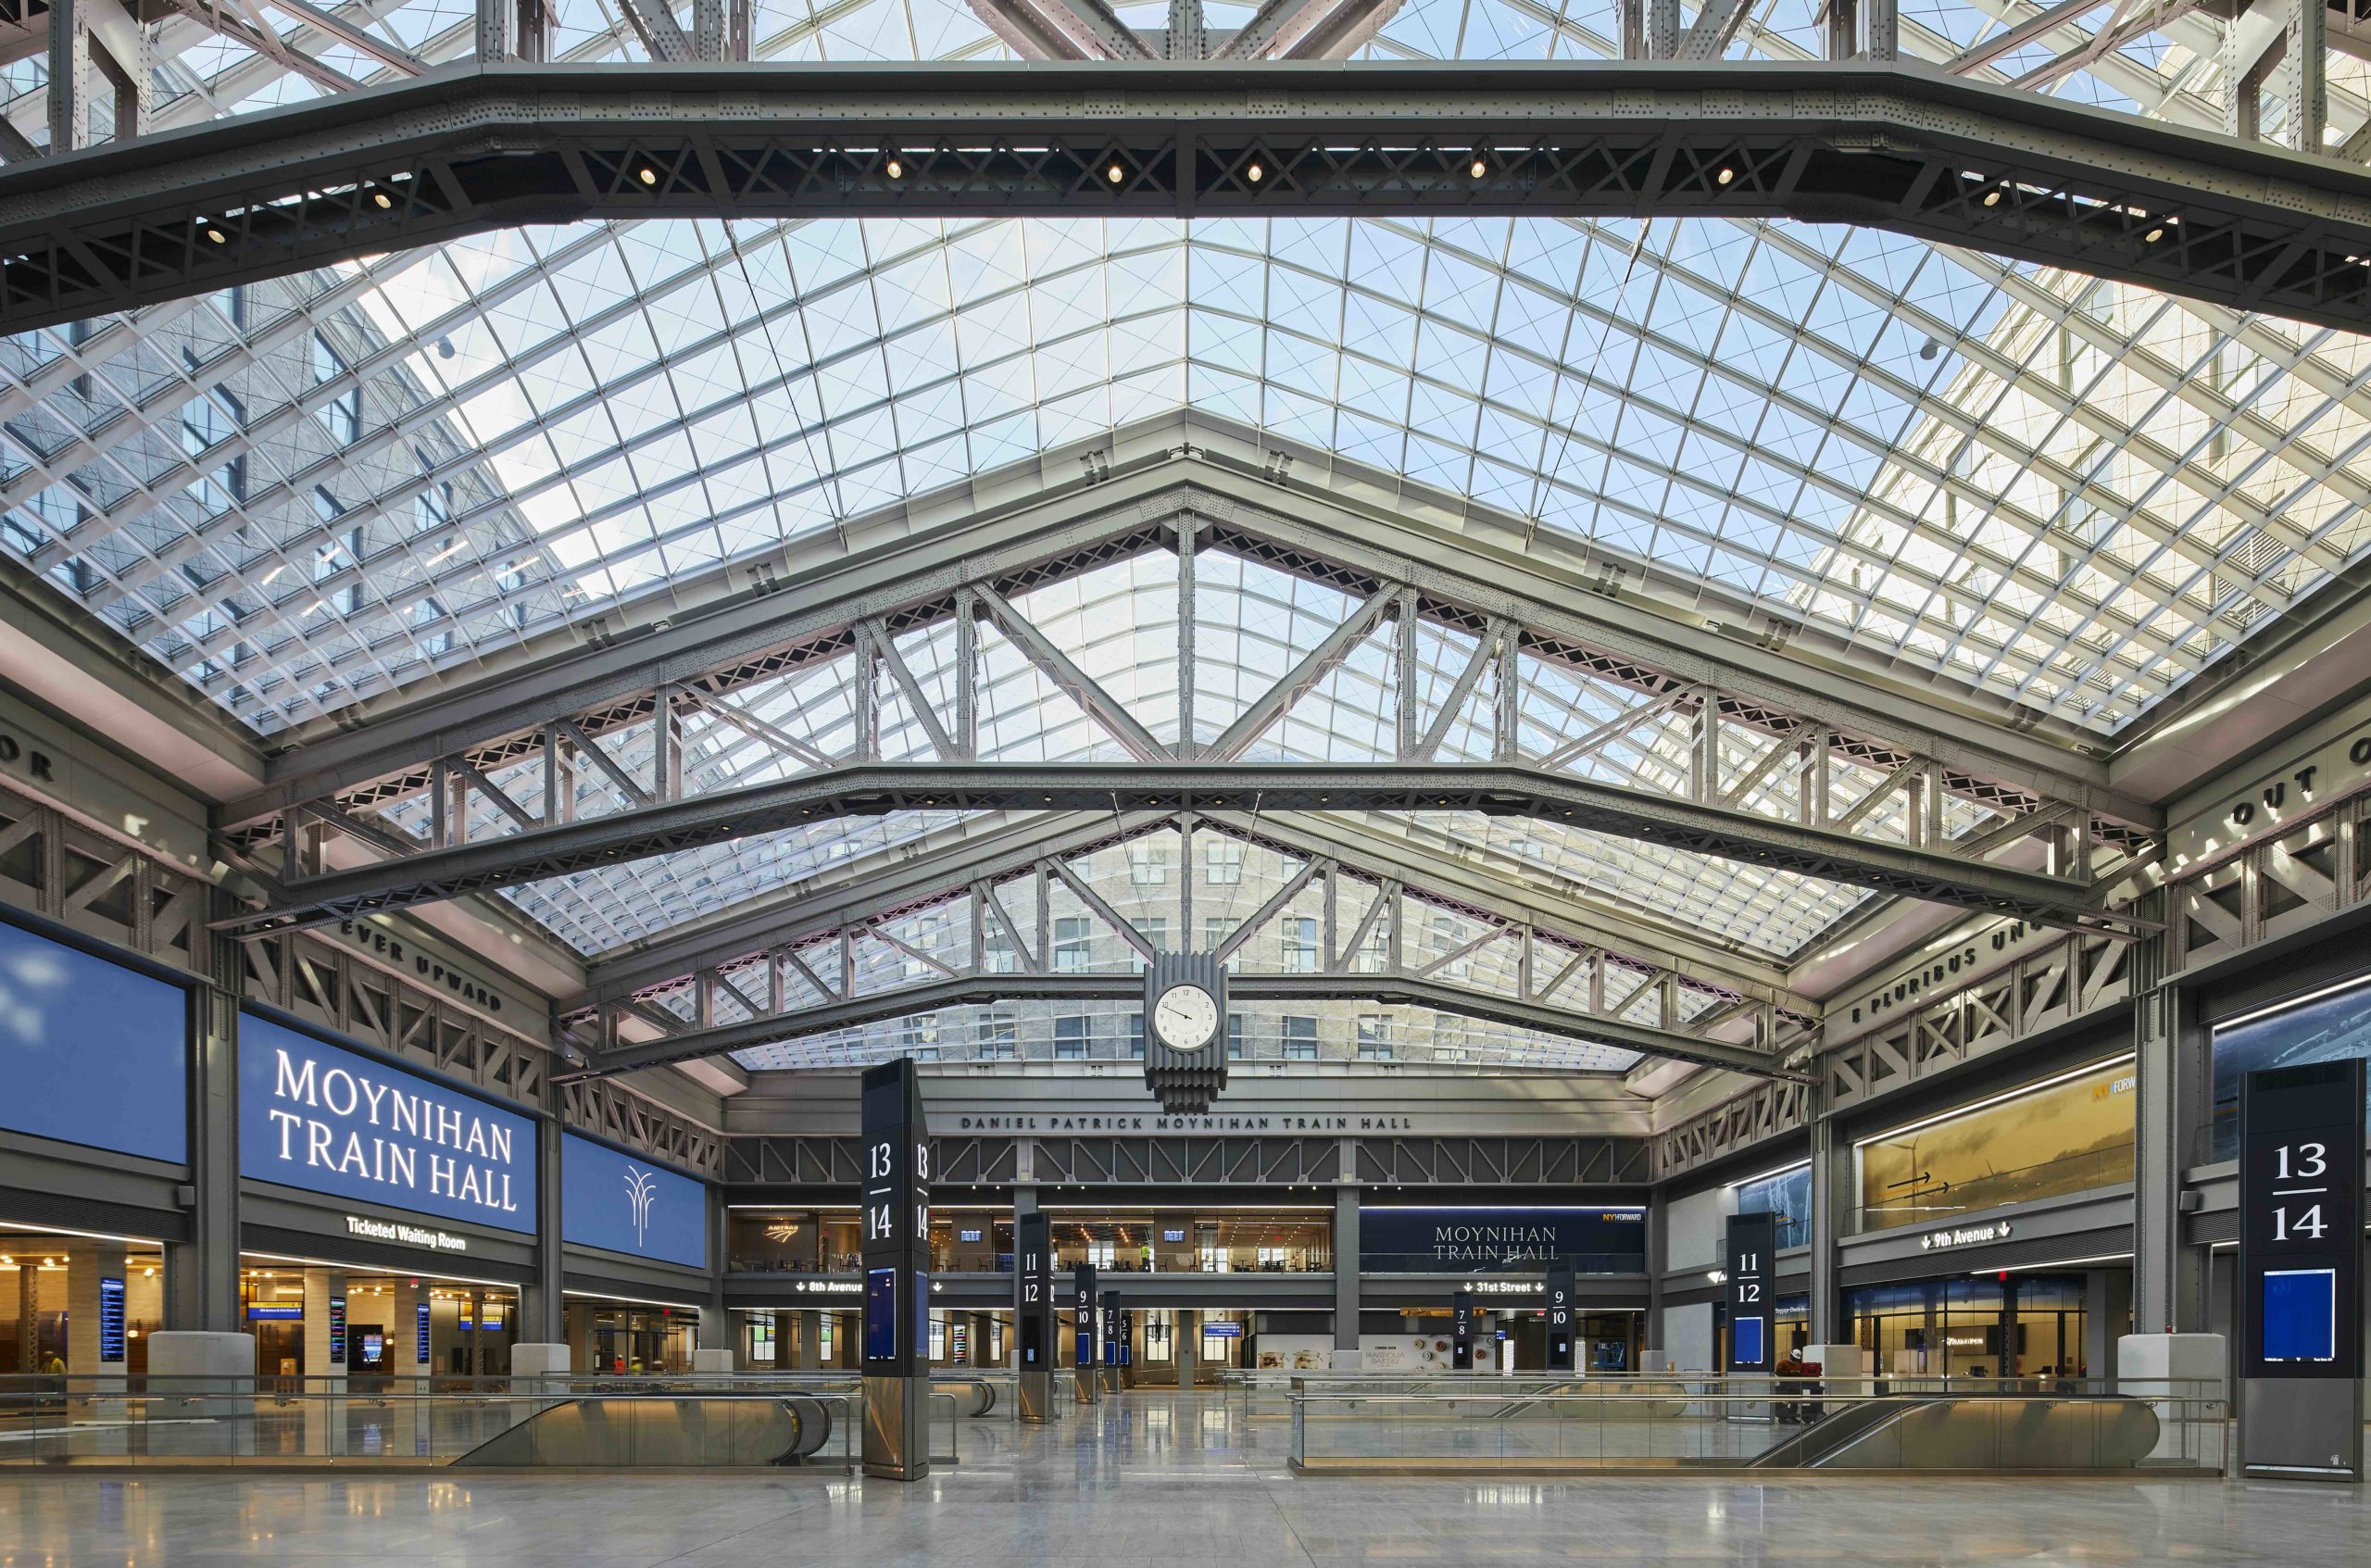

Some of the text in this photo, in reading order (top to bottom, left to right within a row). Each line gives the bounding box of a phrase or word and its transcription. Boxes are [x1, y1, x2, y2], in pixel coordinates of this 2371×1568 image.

[2233, 766, 2317, 825] OUT
[341, 920, 501, 1011] EVER UPWARD
[1852, 1008, 1861, 1023] E
[1871, 947, 1976, 1015] PLURIBUS
[274, 1048, 512, 1164] MOYNIHAN
[961, 1117, 1411, 1129] DANIEL PATRICK MOYNIHAN TRAIN HALL
[270, 1110, 517, 1211] TRAIN HALL
[870, 1142, 891, 1179] 13
[917, 1143, 928, 1180] 13
[2274, 1142, 2327, 1180] 13
[870, 1204, 893, 1240] 14
[917, 1204, 928, 1241] 14
[2271, 1204, 2328, 1241] 14
[345, 1216, 466, 1250] Ticketed Waiting Room
[1436, 1226, 1556, 1242] MOYNIHAN
[1934, 1227, 1995, 1248] 9th Avenue
[1025, 1252, 1036, 1271] 11
[1434, 1245, 1560, 1261] TRAIN HALL
[1739, 1252, 1758, 1272] 11
[809, 1282, 863, 1292] 8th Avenue
[1024, 1284, 1038, 1302] 12
[1476, 1282, 1531, 1292] 31st Street
[1737, 1284, 1760, 1303] 12
[1080, 1290, 1087, 1303] 9
[1555, 1290, 1564, 1303] 9
[1078, 1311, 1089, 1323] 10
[1108, 1310, 1113, 1320] 7
[1122, 1320, 1127, 1328] 5
[1459, 1310, 1465, 1320] 7
[1552, 1311, 1567, 1324] 10
[1108, 1324, 1113, 1335] 8
[1122, 1332, 1127, 1340] 6
[1459, 1325, 1465, 1336] 8
